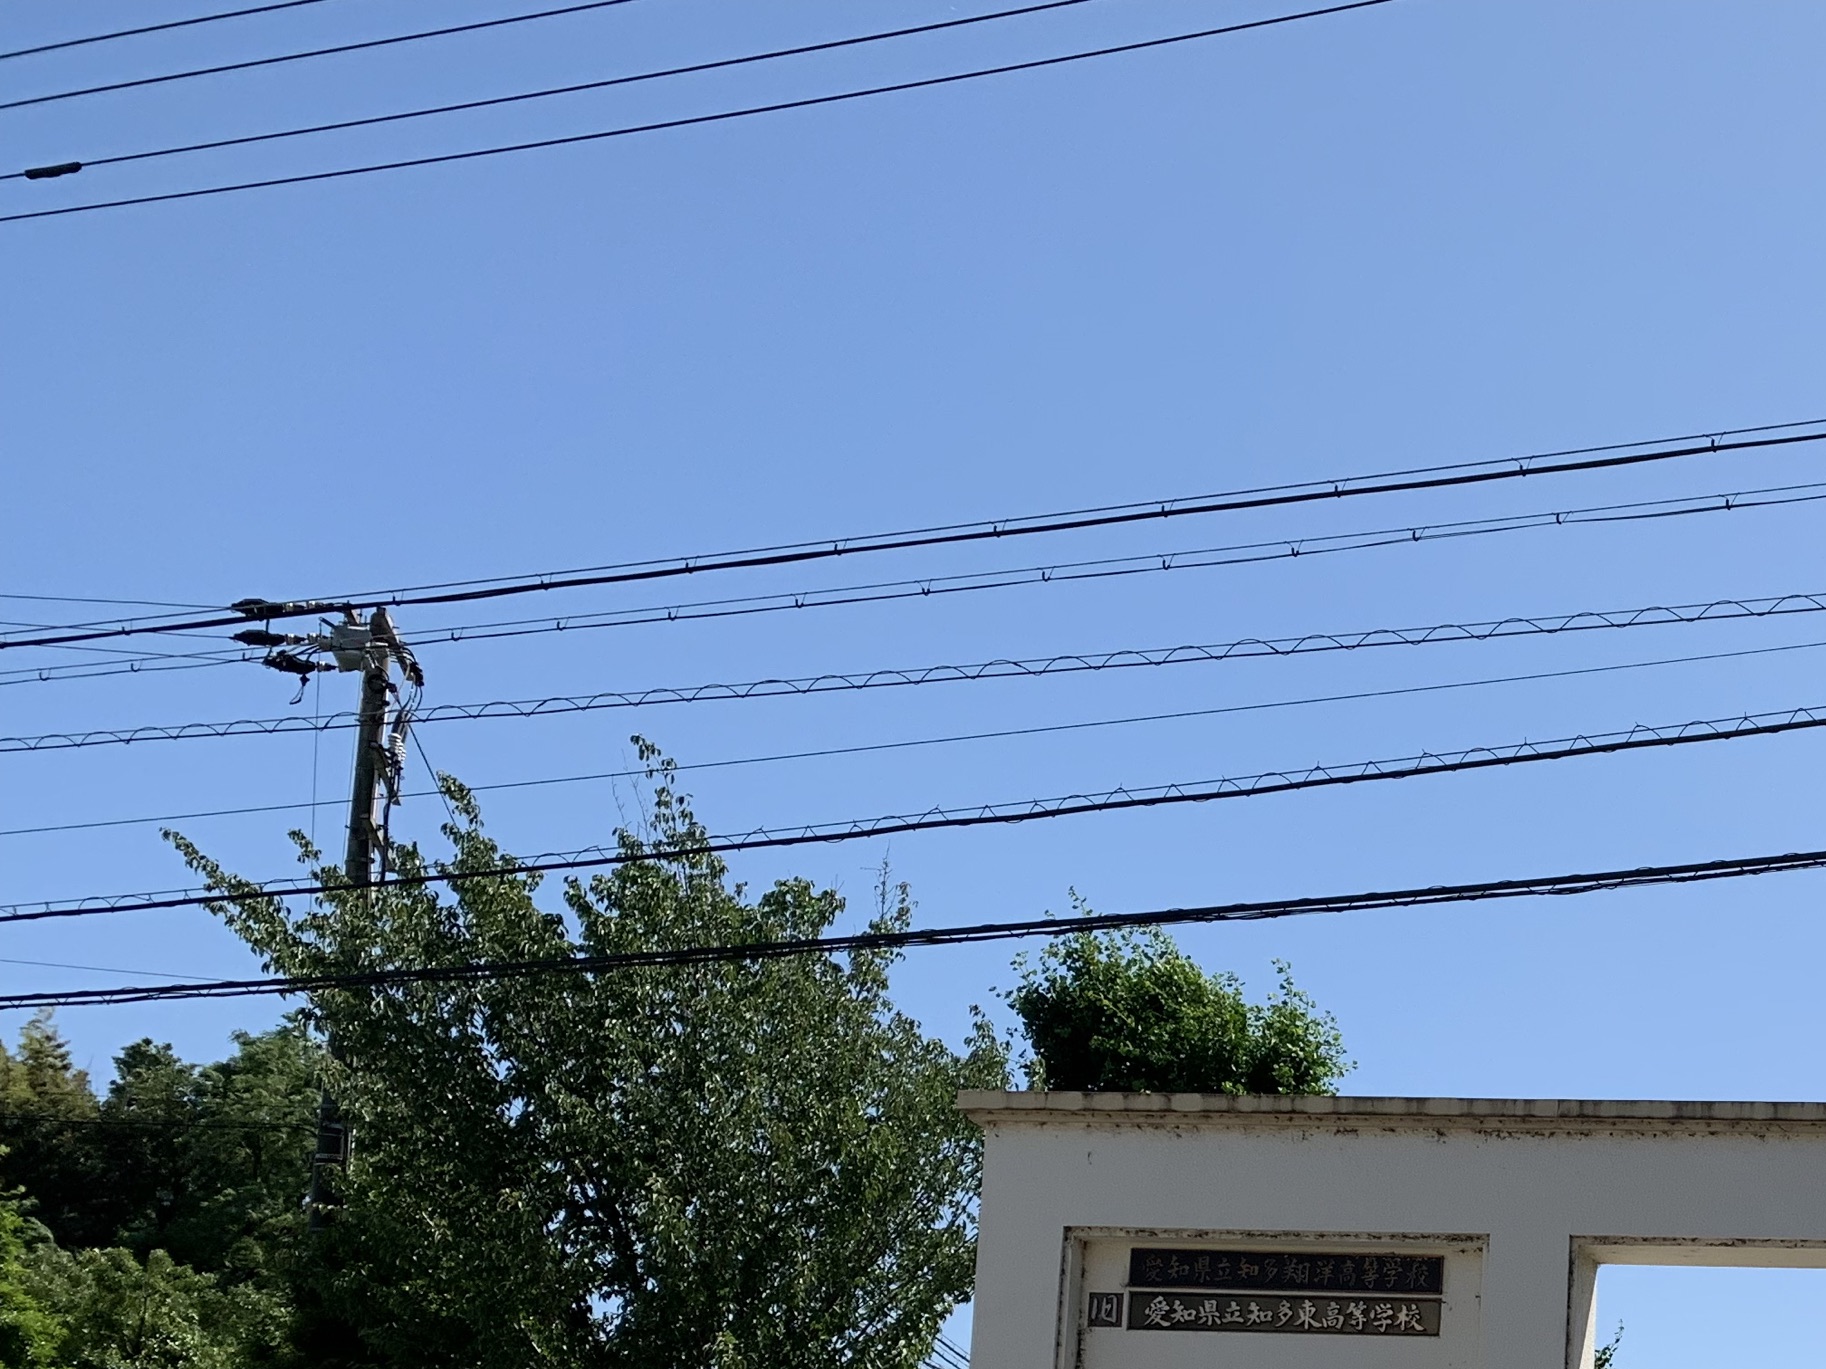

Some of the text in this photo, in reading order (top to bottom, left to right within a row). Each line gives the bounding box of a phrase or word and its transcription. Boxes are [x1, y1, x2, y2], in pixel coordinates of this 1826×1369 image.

[1142, 1254, 1431, 1289] 愛知県立知多翔洋高等学校
[1090, 1294, 1118, 1323] 旧
[1143, 1295, 1427, 1333] 愛知県立知多東高等学校
